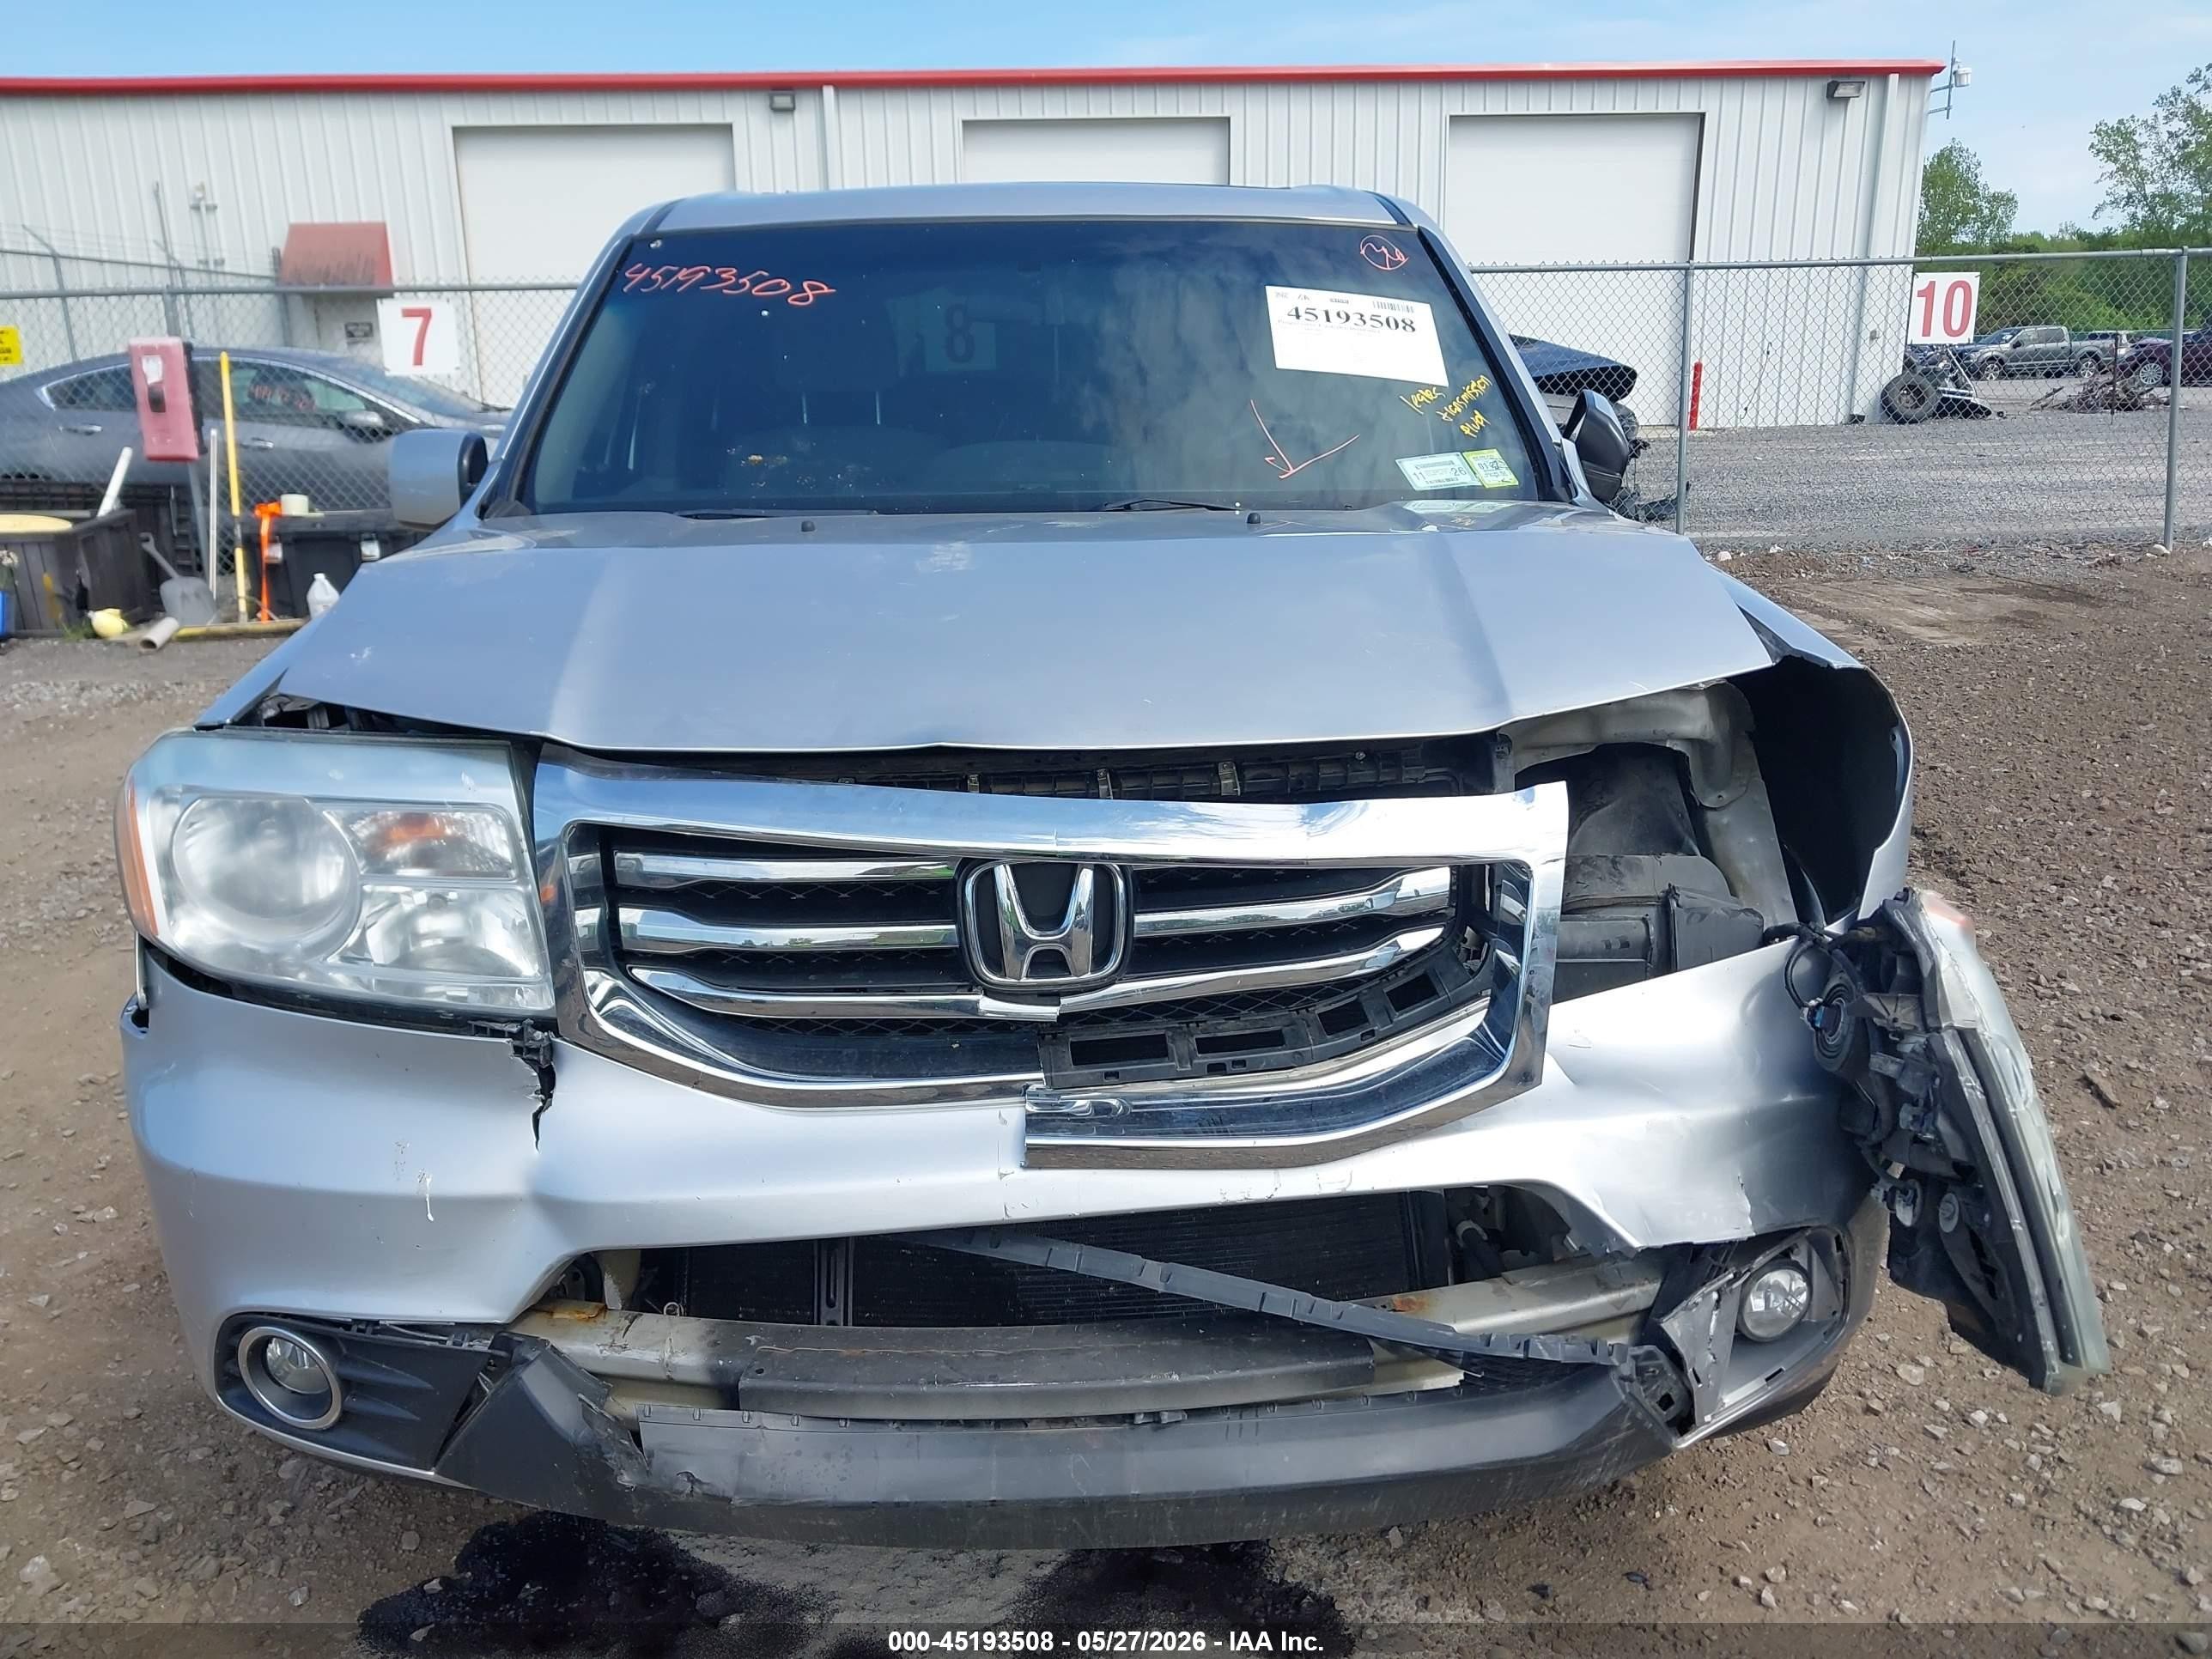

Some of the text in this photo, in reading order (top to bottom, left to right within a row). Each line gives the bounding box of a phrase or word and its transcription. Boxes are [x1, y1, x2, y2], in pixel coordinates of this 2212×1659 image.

[623, 263, 836, 306] 45193508
[1917, 280, 1972, 337] 10
[401, 307, 432, 366] 7
[1287, 306, 1416, 332] 45193508
